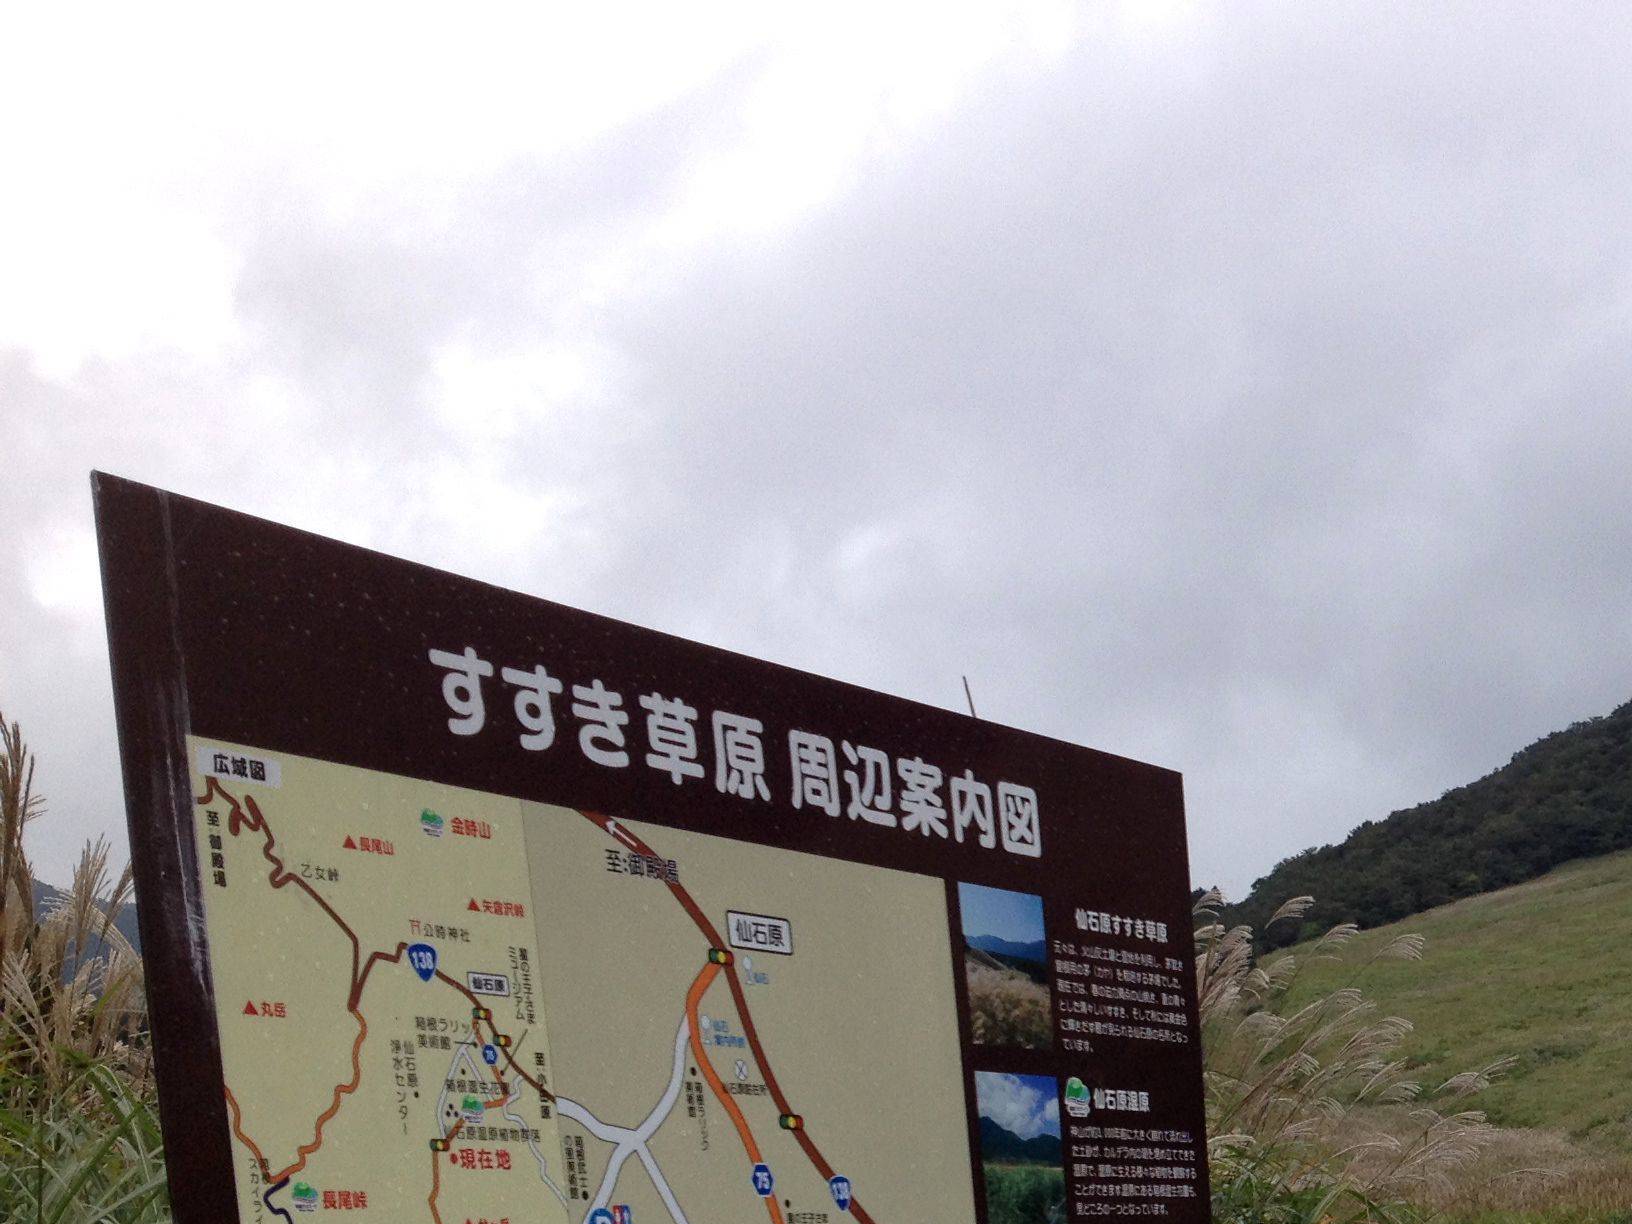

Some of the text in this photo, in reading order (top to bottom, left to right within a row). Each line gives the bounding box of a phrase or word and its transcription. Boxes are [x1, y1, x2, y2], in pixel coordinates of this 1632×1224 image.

[428, 646, 1042, 858] すすき草原 周辺案内図
[213, 753, 265, 782] 広域図
[736, 917, 785, 946] 仙石原
[1074, 907, 1168, 944] 仙石原すすき草原
[412, 951, 433, 970] 138
[459, 1148, 512, 1171] 現在地
